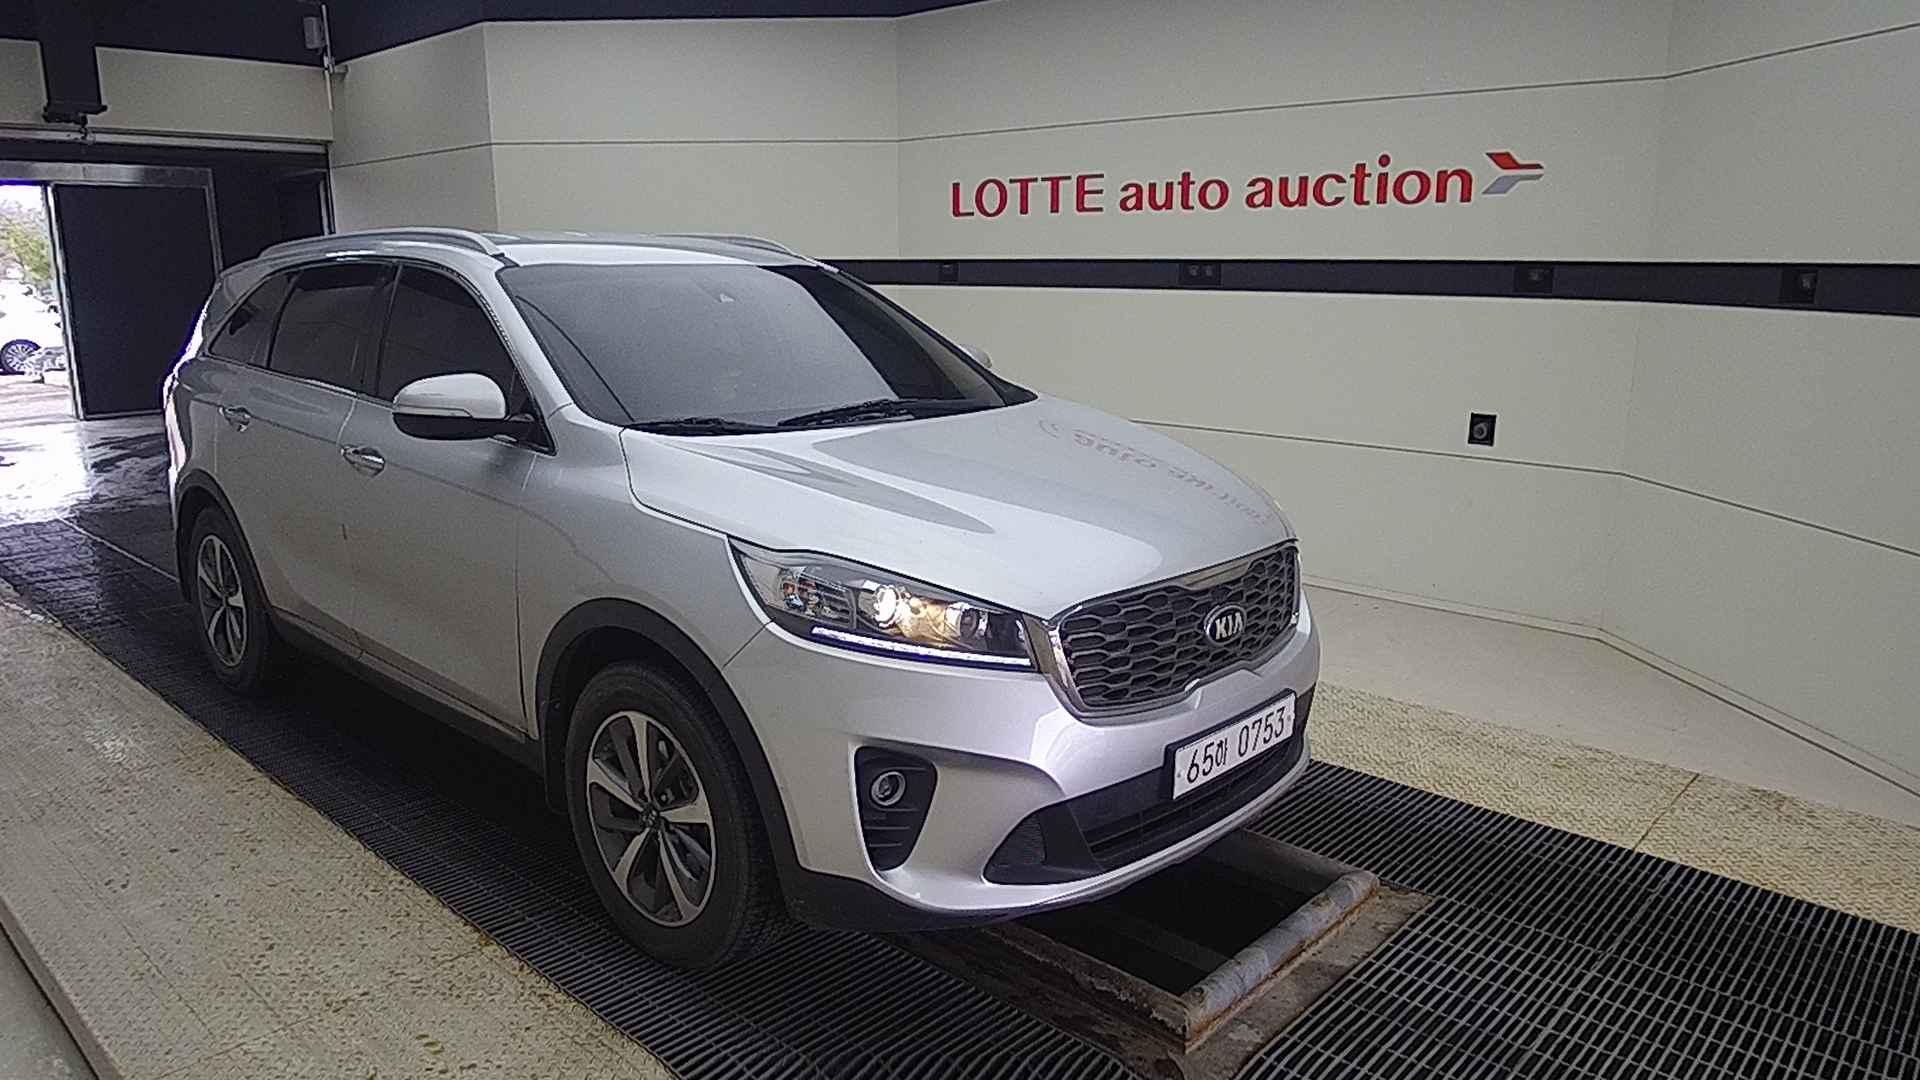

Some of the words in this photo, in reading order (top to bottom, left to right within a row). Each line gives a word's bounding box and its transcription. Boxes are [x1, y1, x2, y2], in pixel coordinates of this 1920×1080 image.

[951, 174, 1104, 218] LOTTE
[1119, 172, 1229, 212] auto
[1245, 154, 1474, 208] auction
[1215, 612, 1244, 640] KIA
[1238, 706, 1286, 758] 0753
